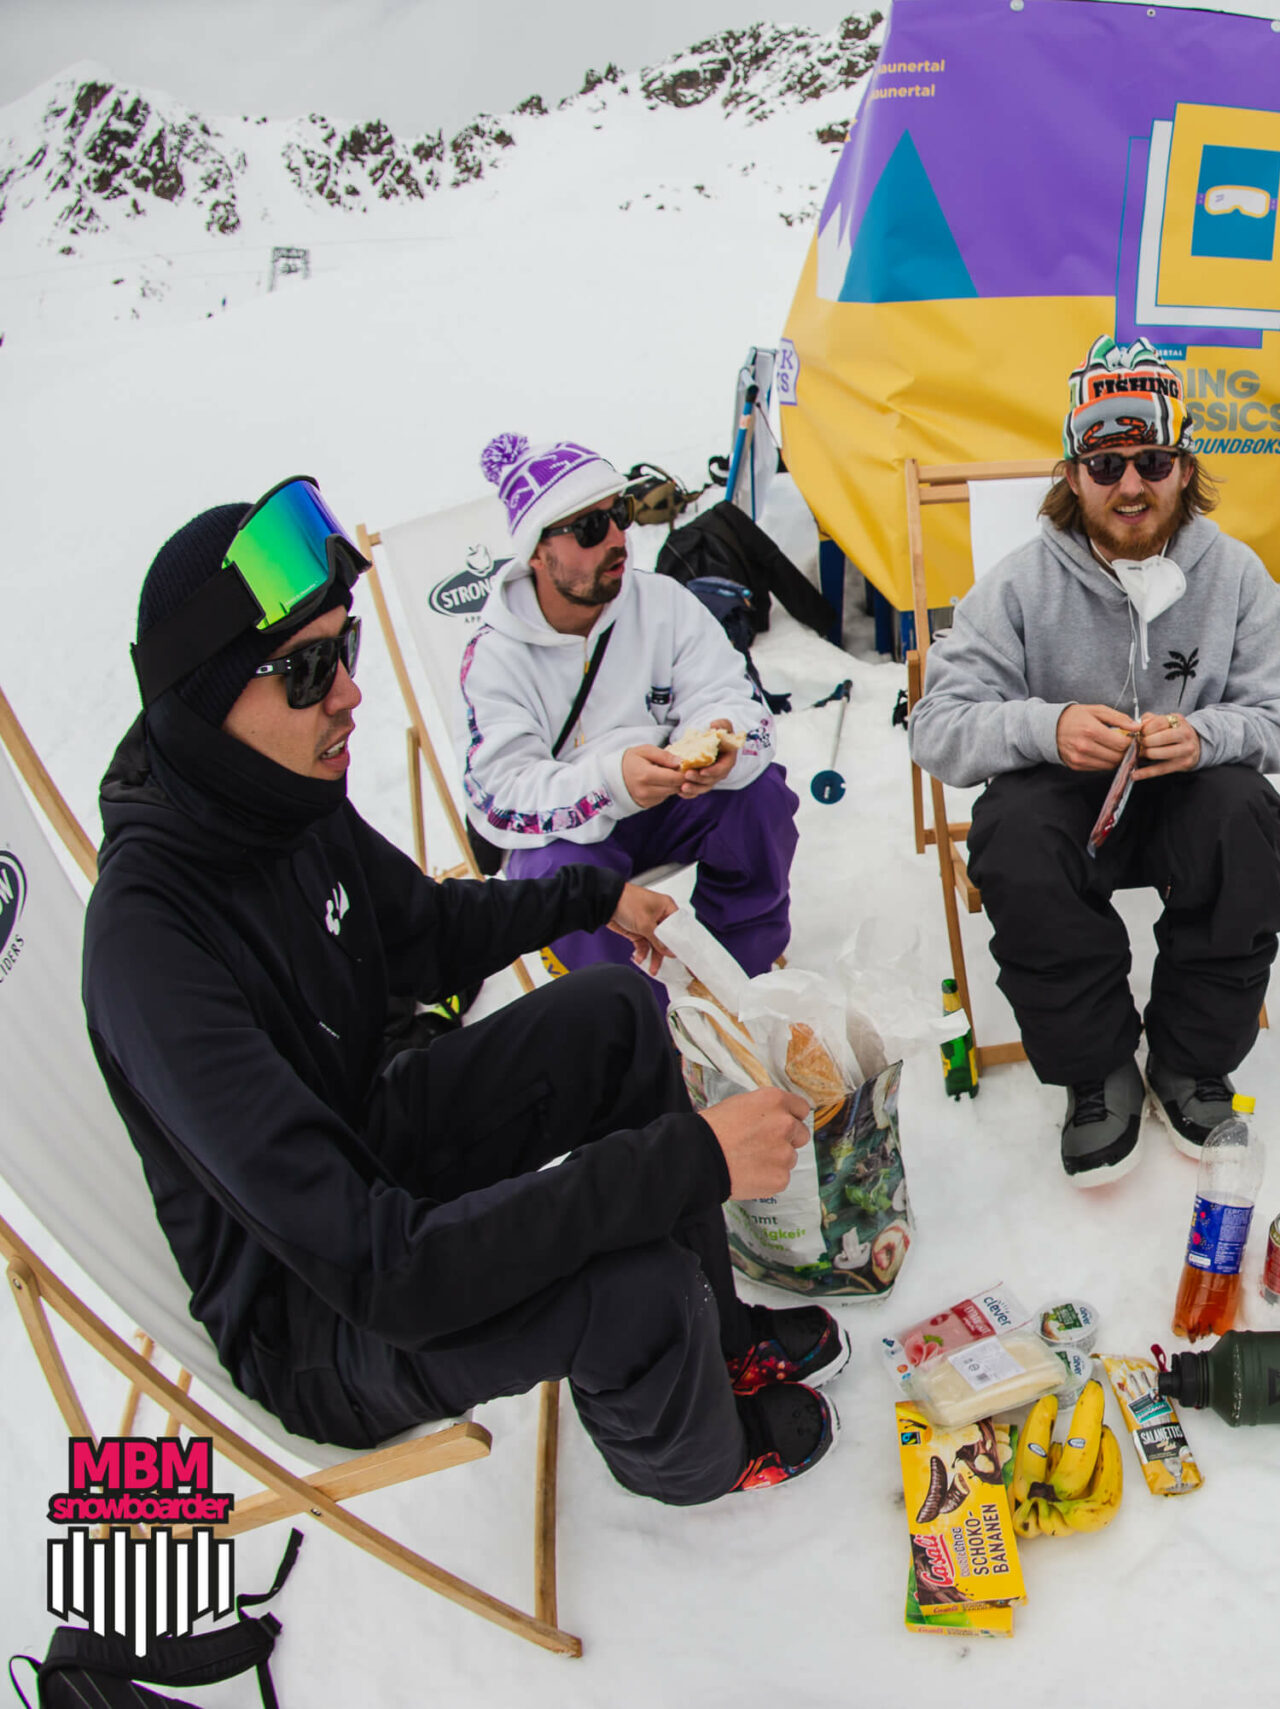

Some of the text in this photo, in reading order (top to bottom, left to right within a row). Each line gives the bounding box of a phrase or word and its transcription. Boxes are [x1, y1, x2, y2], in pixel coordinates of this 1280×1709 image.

[1093, 375, 1180, 399] FISHING
[983, 1296, 1011, 1327] clever
[914, 1533, 955, 1587] Casali
[966, 1511, 989, 1576] SCHOKO-
[981, 1503, 1010, 1574] BANANEN
